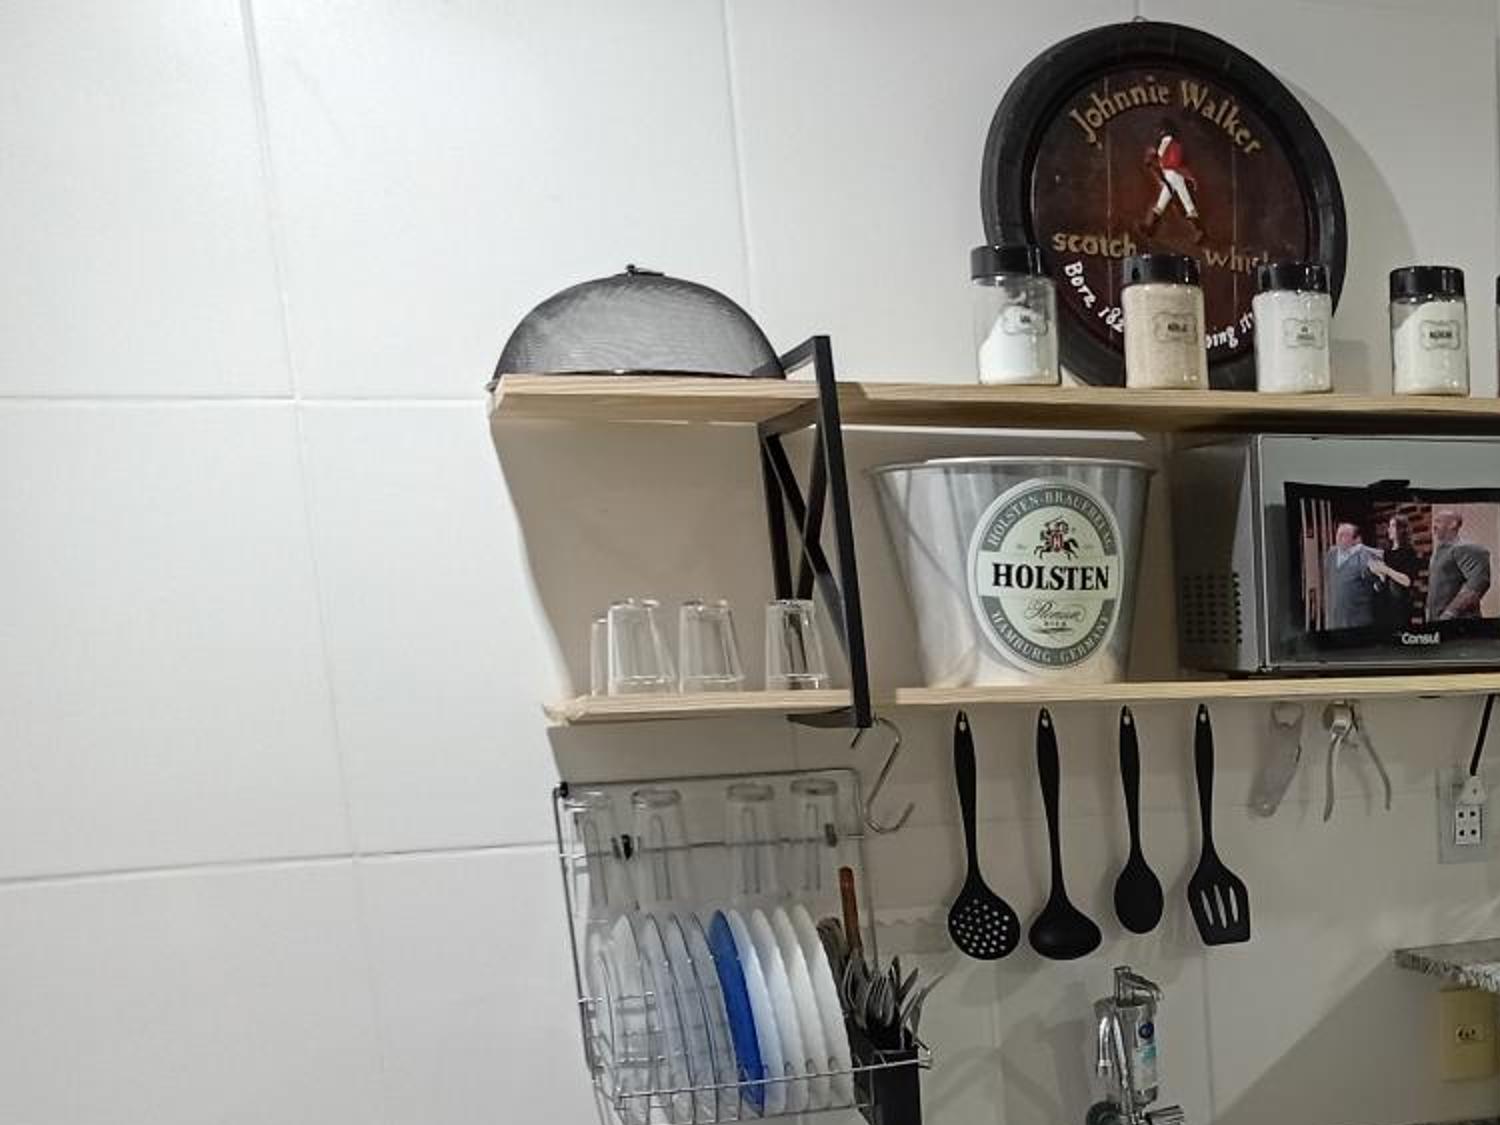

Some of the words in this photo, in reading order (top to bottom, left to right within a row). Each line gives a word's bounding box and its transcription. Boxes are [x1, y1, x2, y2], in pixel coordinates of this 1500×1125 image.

[1069, 84, 1169, 146] Johnnie
[1181, 79, 1262, 154] Walker
[1053, 232, 1137, 258] scotch
[1064, 261, 1097, 308] Born
[1098, 306, 1124, 334] 182
[992, 563, 1109, 591] HOLSTEN
[1401, 631, 1440, 646] Consul
